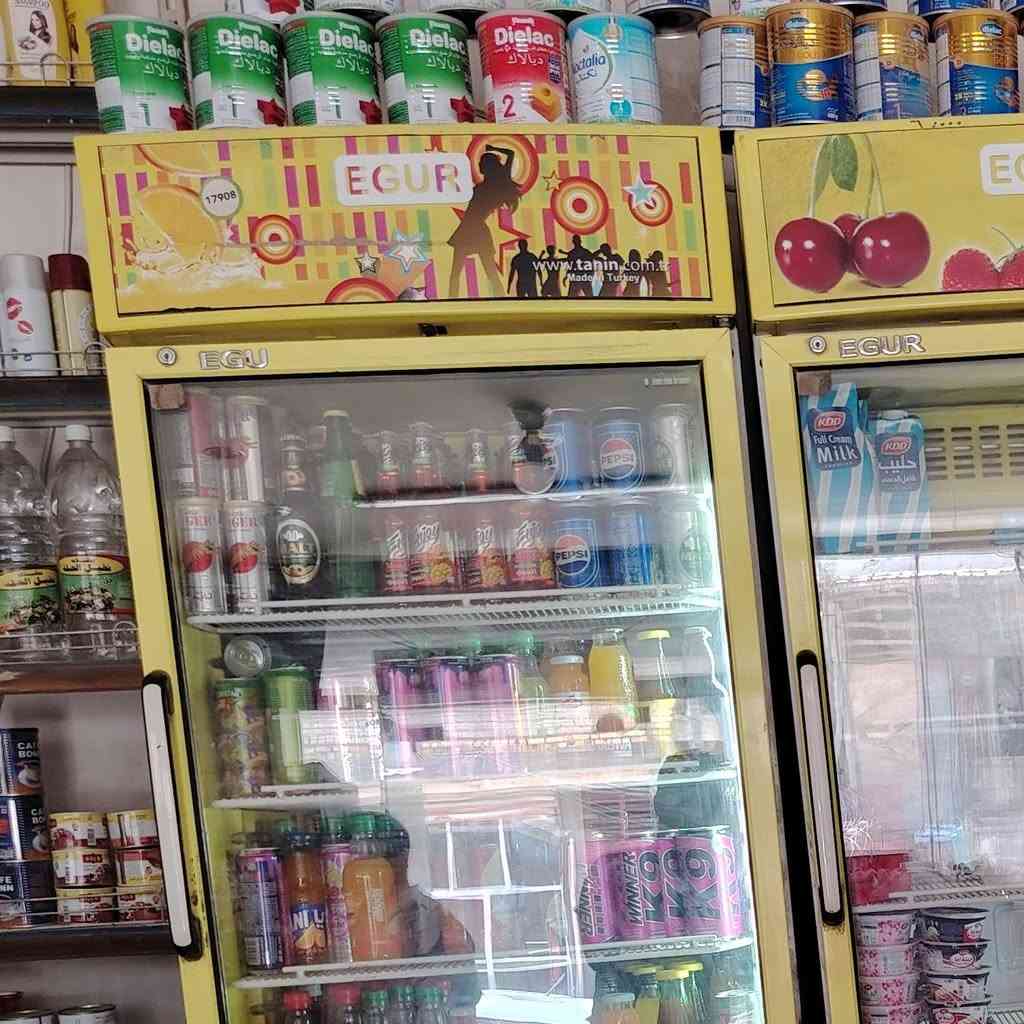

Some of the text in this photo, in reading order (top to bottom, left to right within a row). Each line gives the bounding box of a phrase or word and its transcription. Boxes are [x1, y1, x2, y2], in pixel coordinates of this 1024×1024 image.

[218, 28, 277, 58] Dielac
[319, 28, 374, 56] Dielac
[410, 28, 465, 51] Dielac
[494, 27, 554, 48] Dielac
[502, 94, 516, 118] 2
[345, 163, 459, 196] EGUR
[205, 190, 237, 204] 17908
[567, 273, 593, 282] Made
[607, 273, 641, 283] Turkey
[838, 334, 926, 358] EGUR
[199, 348, 269, 370] EGU
[816, 415, 842, 428] KDD
[817, 446, 858, 463] Milk
[885, 440, 908, 450] KDD
[601, 449, 633, 467] PEPSI
[880, 455, 917, 474] حليب
[555, 549, 588, 561] PEPSI
[624, 849, 645, 927] WINNER
